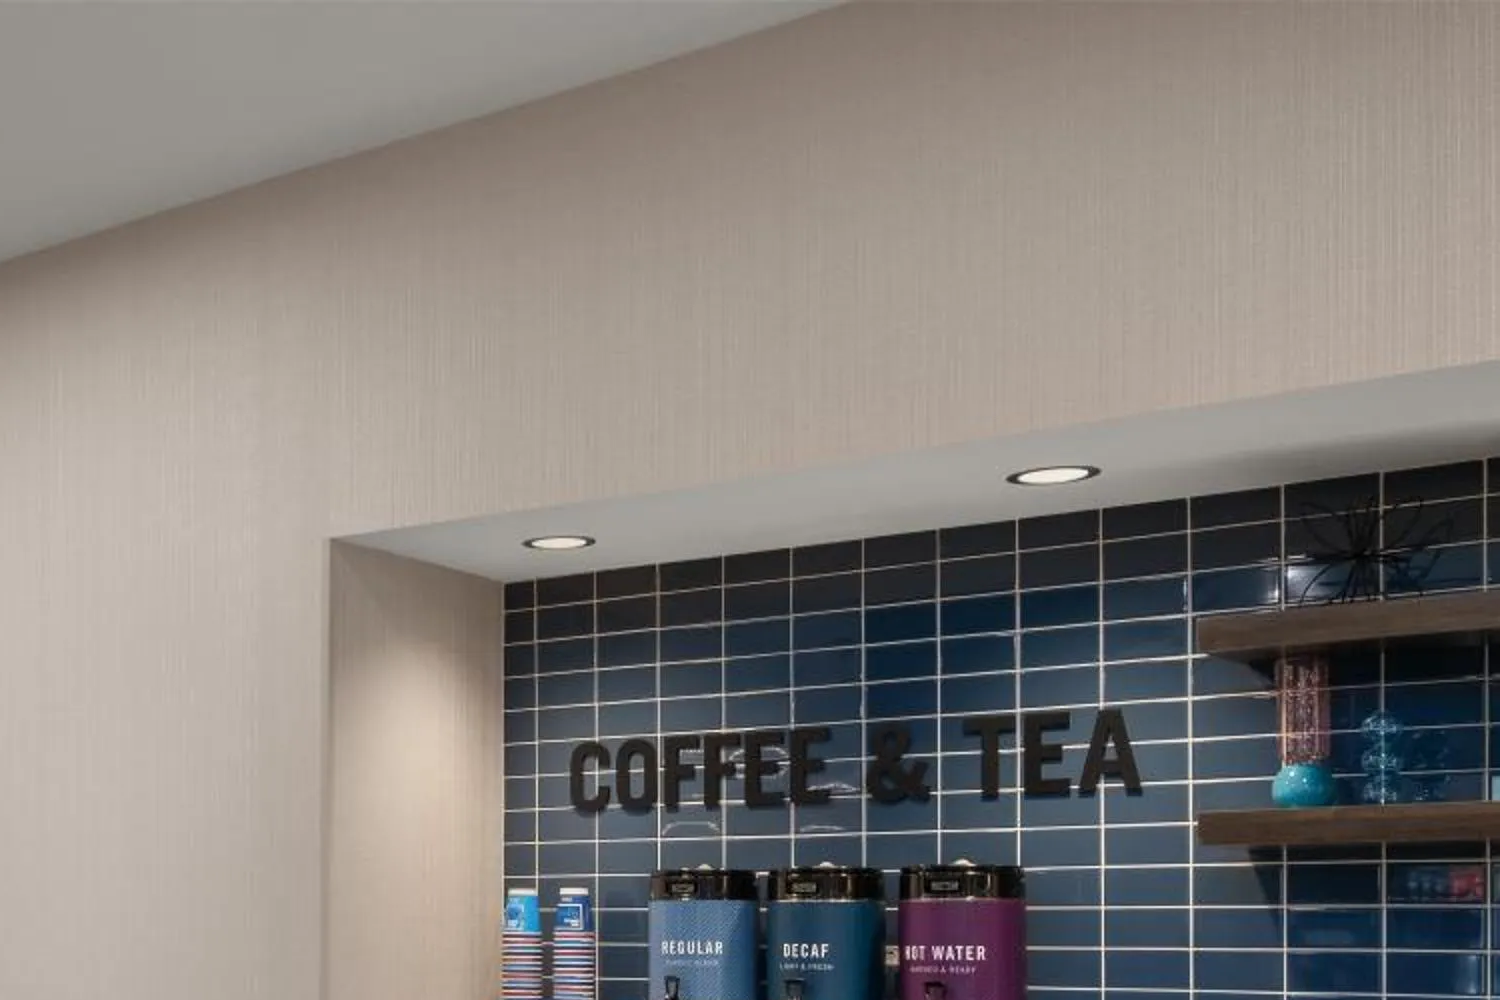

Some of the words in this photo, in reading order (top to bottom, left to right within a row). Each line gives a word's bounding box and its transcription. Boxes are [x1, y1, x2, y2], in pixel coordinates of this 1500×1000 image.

[569, 726, 834, 814] COFFEE
[866, 722, 931, 804] &
[963, 708, 1143, 800] TEA
[661, 940, 724, 955] REGULAR
[783, 943, 829, 959] DECAF
[904, 944, 926, 961] HOT
[931, 944, 987, 961] WATER
